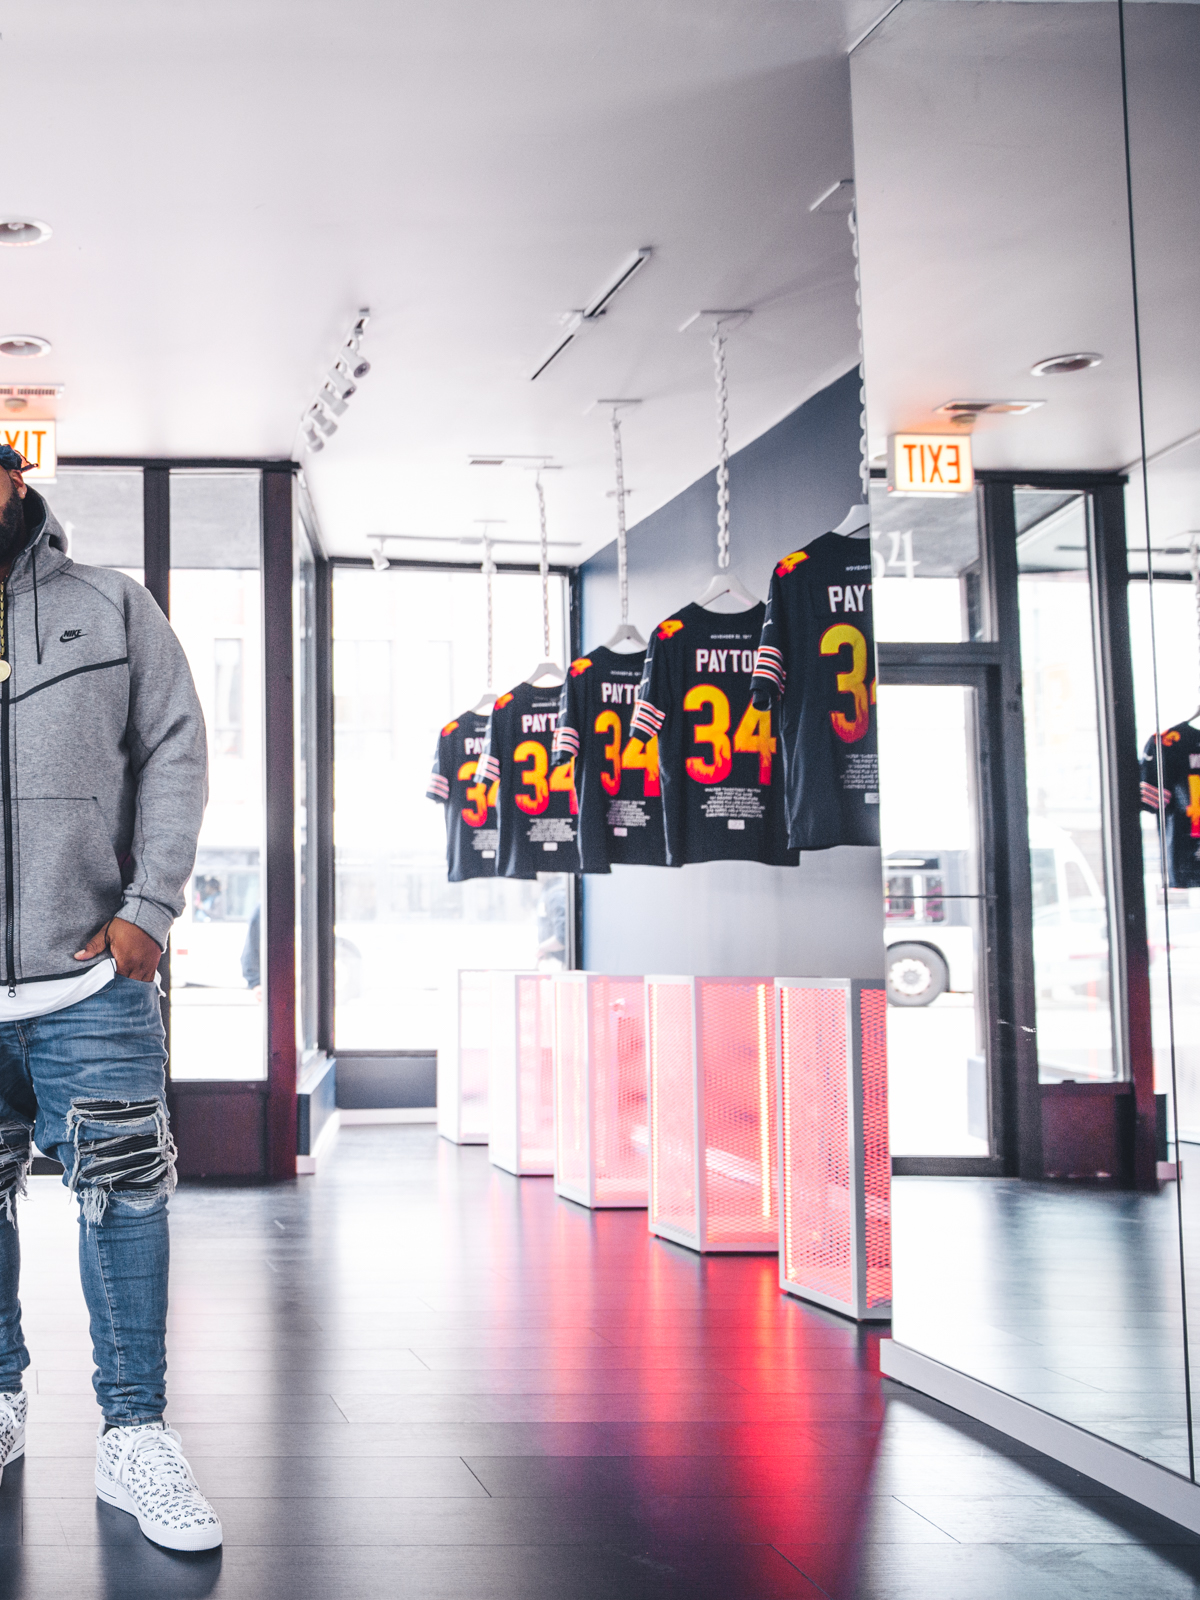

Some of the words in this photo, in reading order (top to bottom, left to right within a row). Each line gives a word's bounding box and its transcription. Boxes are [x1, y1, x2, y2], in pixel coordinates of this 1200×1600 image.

[64, 629, 82, 638] NIKE
[828, 584, 872, 613] PAY
[696, 648, 757, 673] PAYTO
[818, 622, 877, 744] 3
[594, 709, 661, 797] 34
[683, 683, 777, 786] 34
[513, 740, 579, 815] 34
